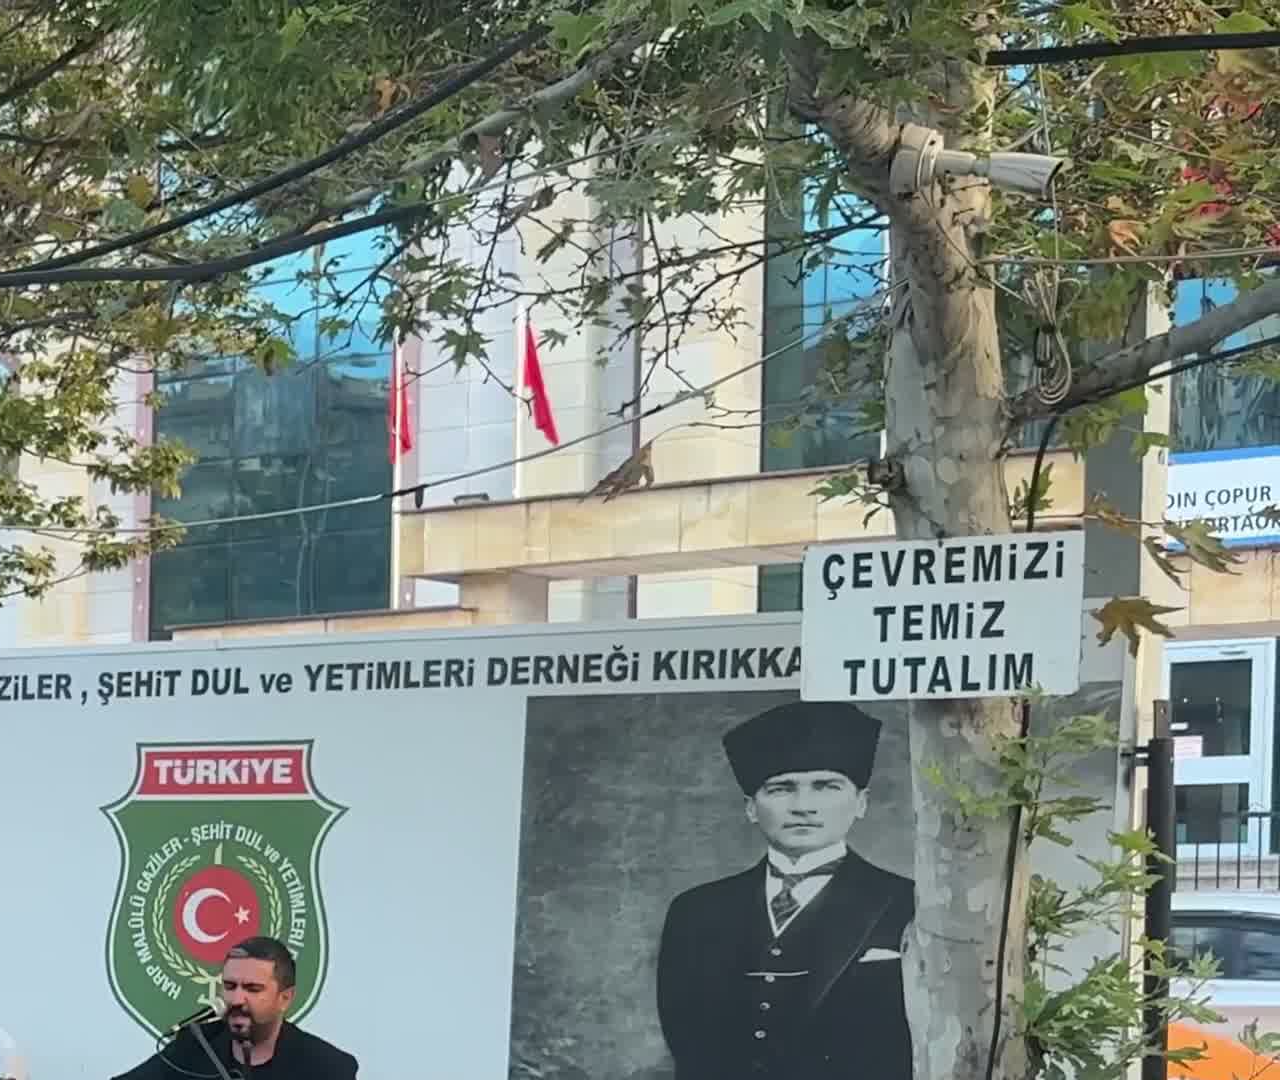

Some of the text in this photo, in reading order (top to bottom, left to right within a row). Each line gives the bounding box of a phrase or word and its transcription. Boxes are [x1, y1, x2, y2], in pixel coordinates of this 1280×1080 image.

[1205, 485, 1272, 511] ÇOPUR
[191, 667, 250, 696] DUL
[260, 671, 293, 694] ve
[843, 652, 1034, 696] TUTALIM
[190, 819, 234, 847] ŞEHİT
[235, 825, 264, 852] DUL
[135, 836, 183, 894] GAZİLER
[264, 843, 281, 864] ve
[277, 856, 307, 948] YETİMLERİ
[145, 962, 183, 1001] HARP
